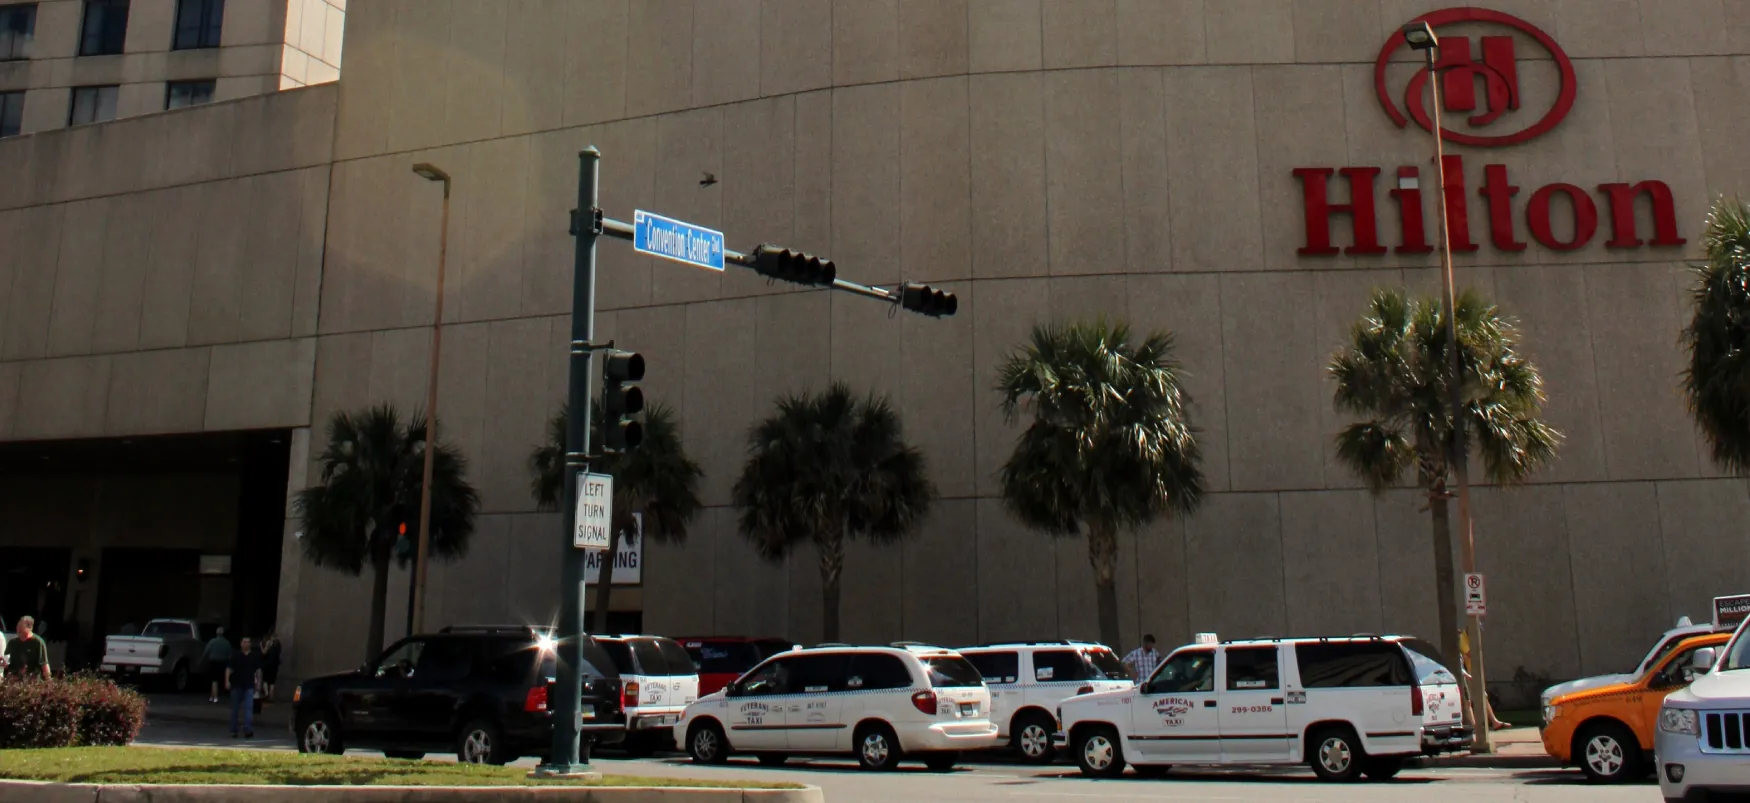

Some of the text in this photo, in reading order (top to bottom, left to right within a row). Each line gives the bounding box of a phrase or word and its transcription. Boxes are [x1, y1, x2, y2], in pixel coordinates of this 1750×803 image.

[1292, 154, 1686, 256] Hilton
[647, 218, 685, 258] Convention
[687, 228, 710, 263] Center
[584, 481, 605, 498] LEFT
[583, 503, 605, 519] TURN
[578, 524, 607, 541] SIGNAL
[586, 551, 637, 569] ARING
[1152, 697, 1194, 709] AMERICAN
[747, 717, 763, 725] TAXI
